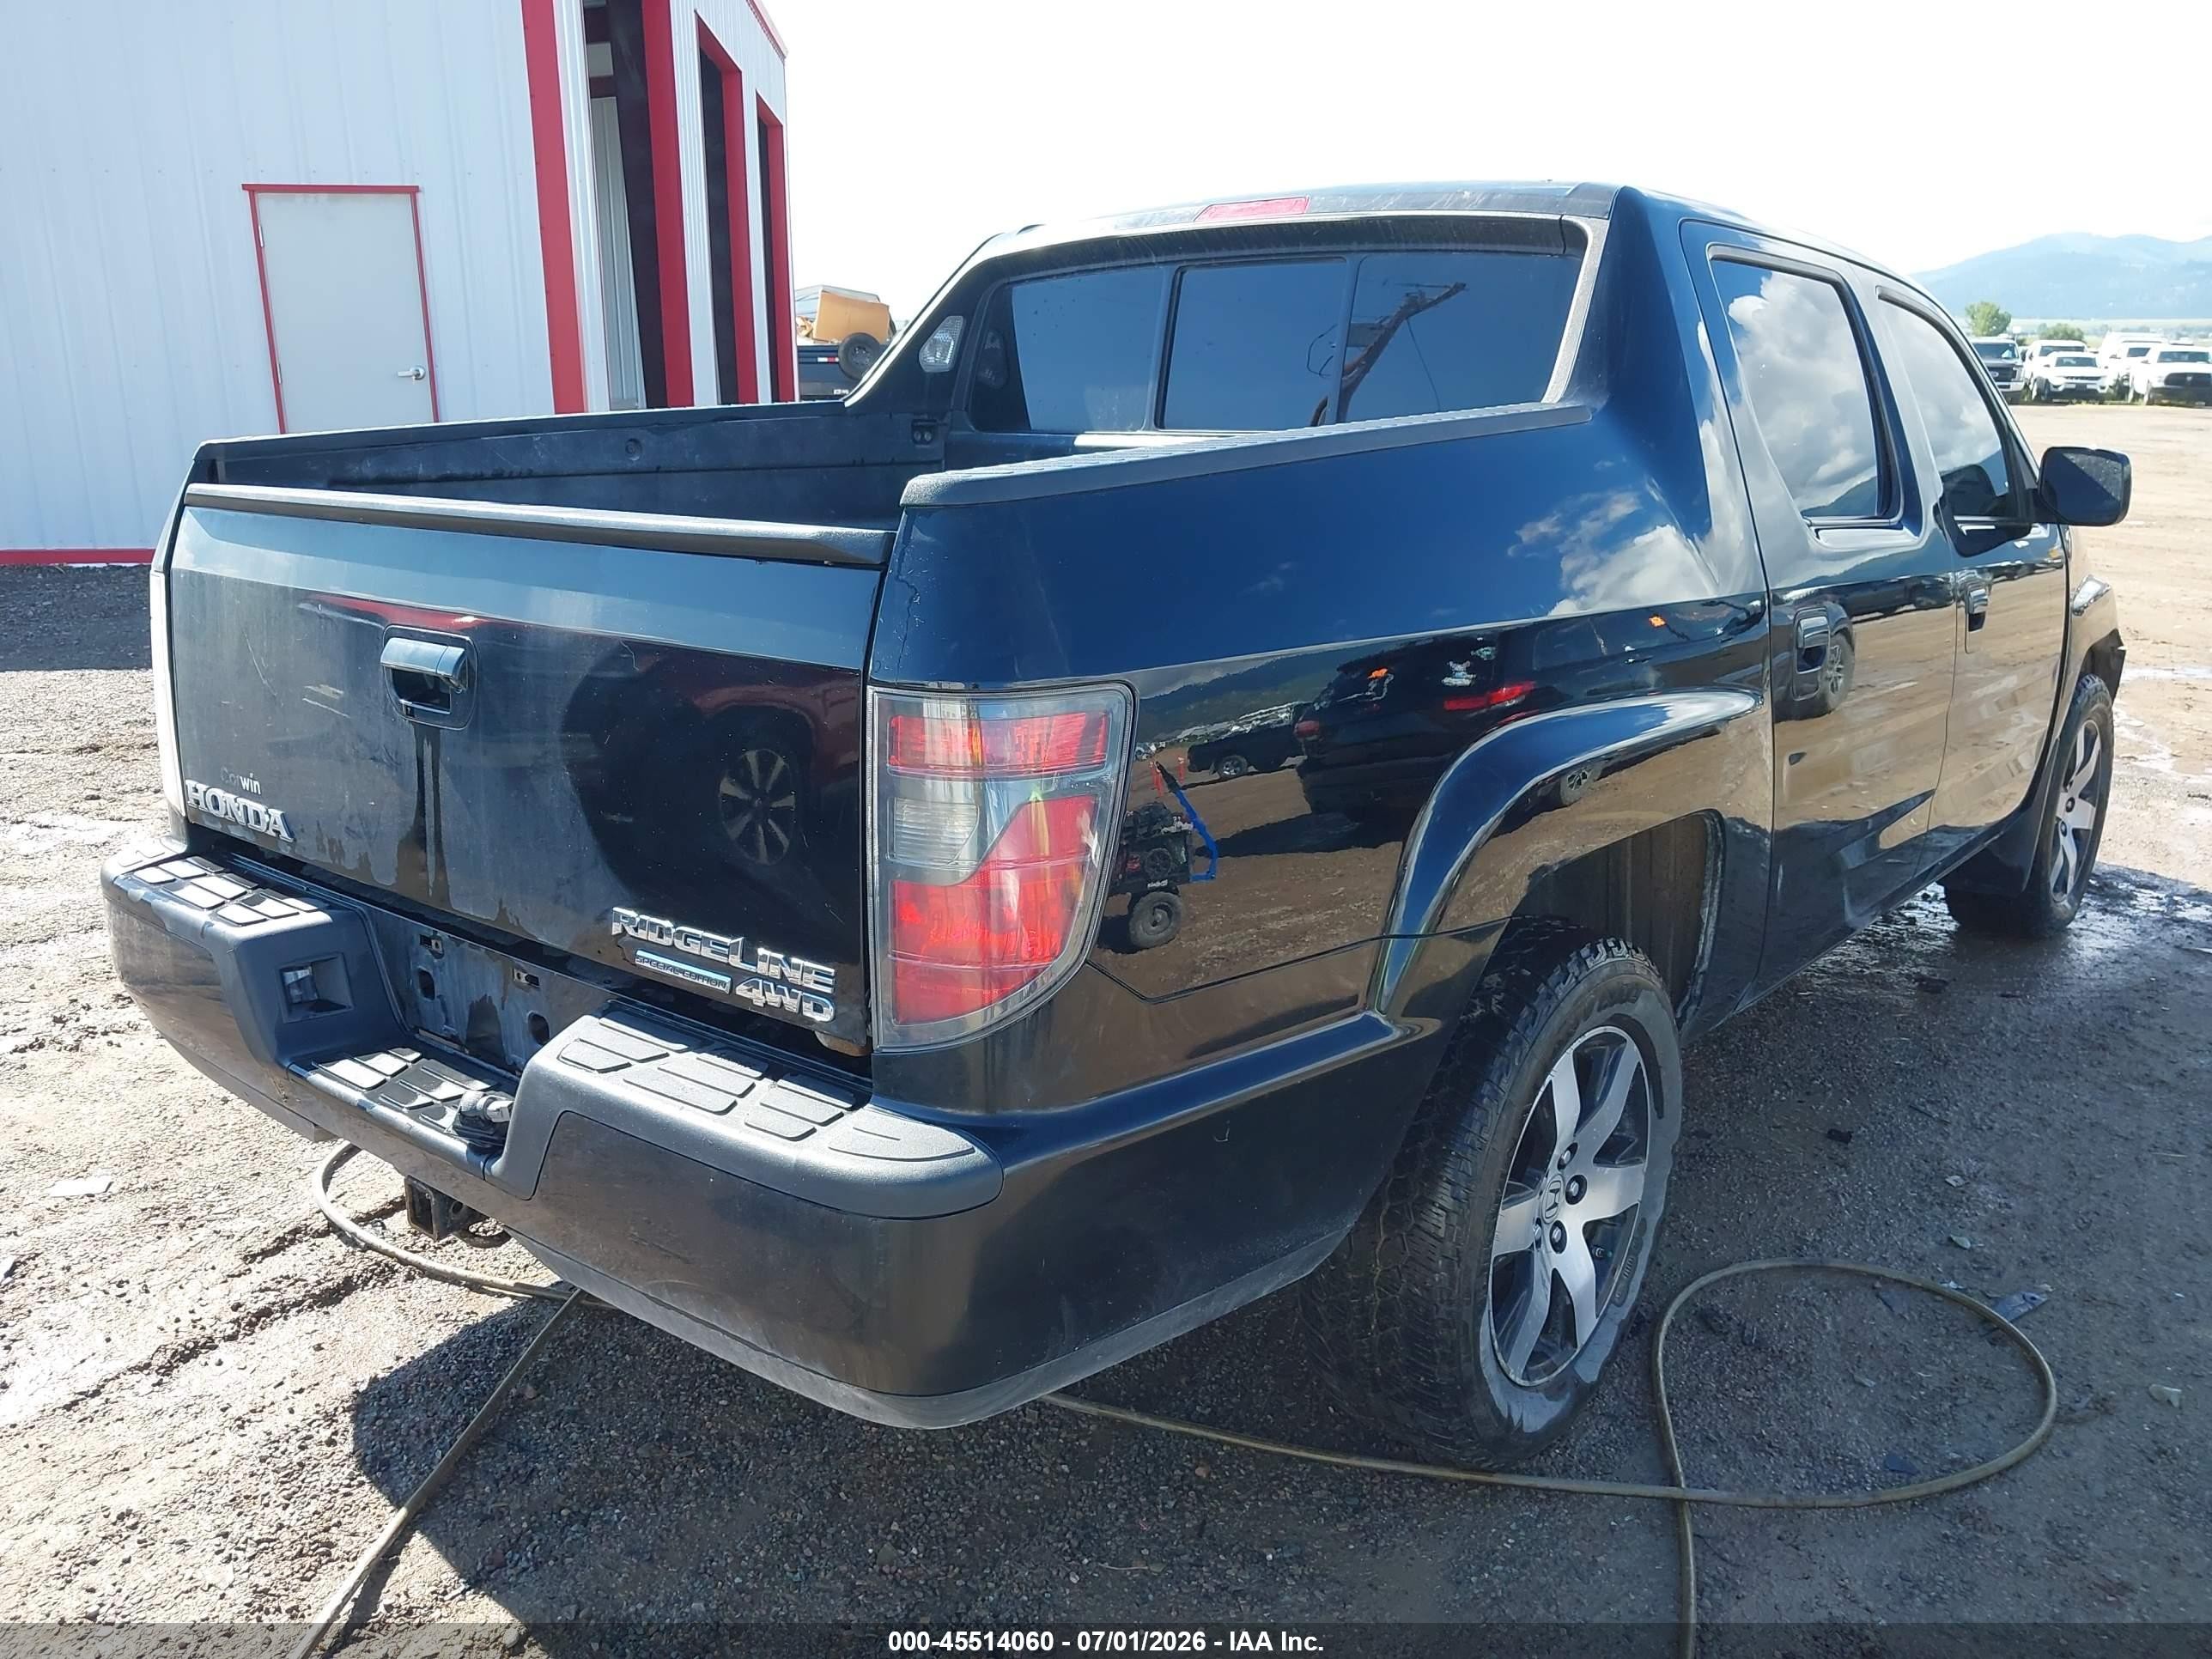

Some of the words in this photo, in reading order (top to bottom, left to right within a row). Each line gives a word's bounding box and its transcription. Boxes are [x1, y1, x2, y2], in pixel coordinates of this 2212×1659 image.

[185, 780, 295, 842] HONDA
[612, 907, 836, 994] RIDGELINE
[635, 956, 680, 976] SPECIAL
[682, 968, 727, 990] EDITION
[735, 977, 835, 1023] 4WD
